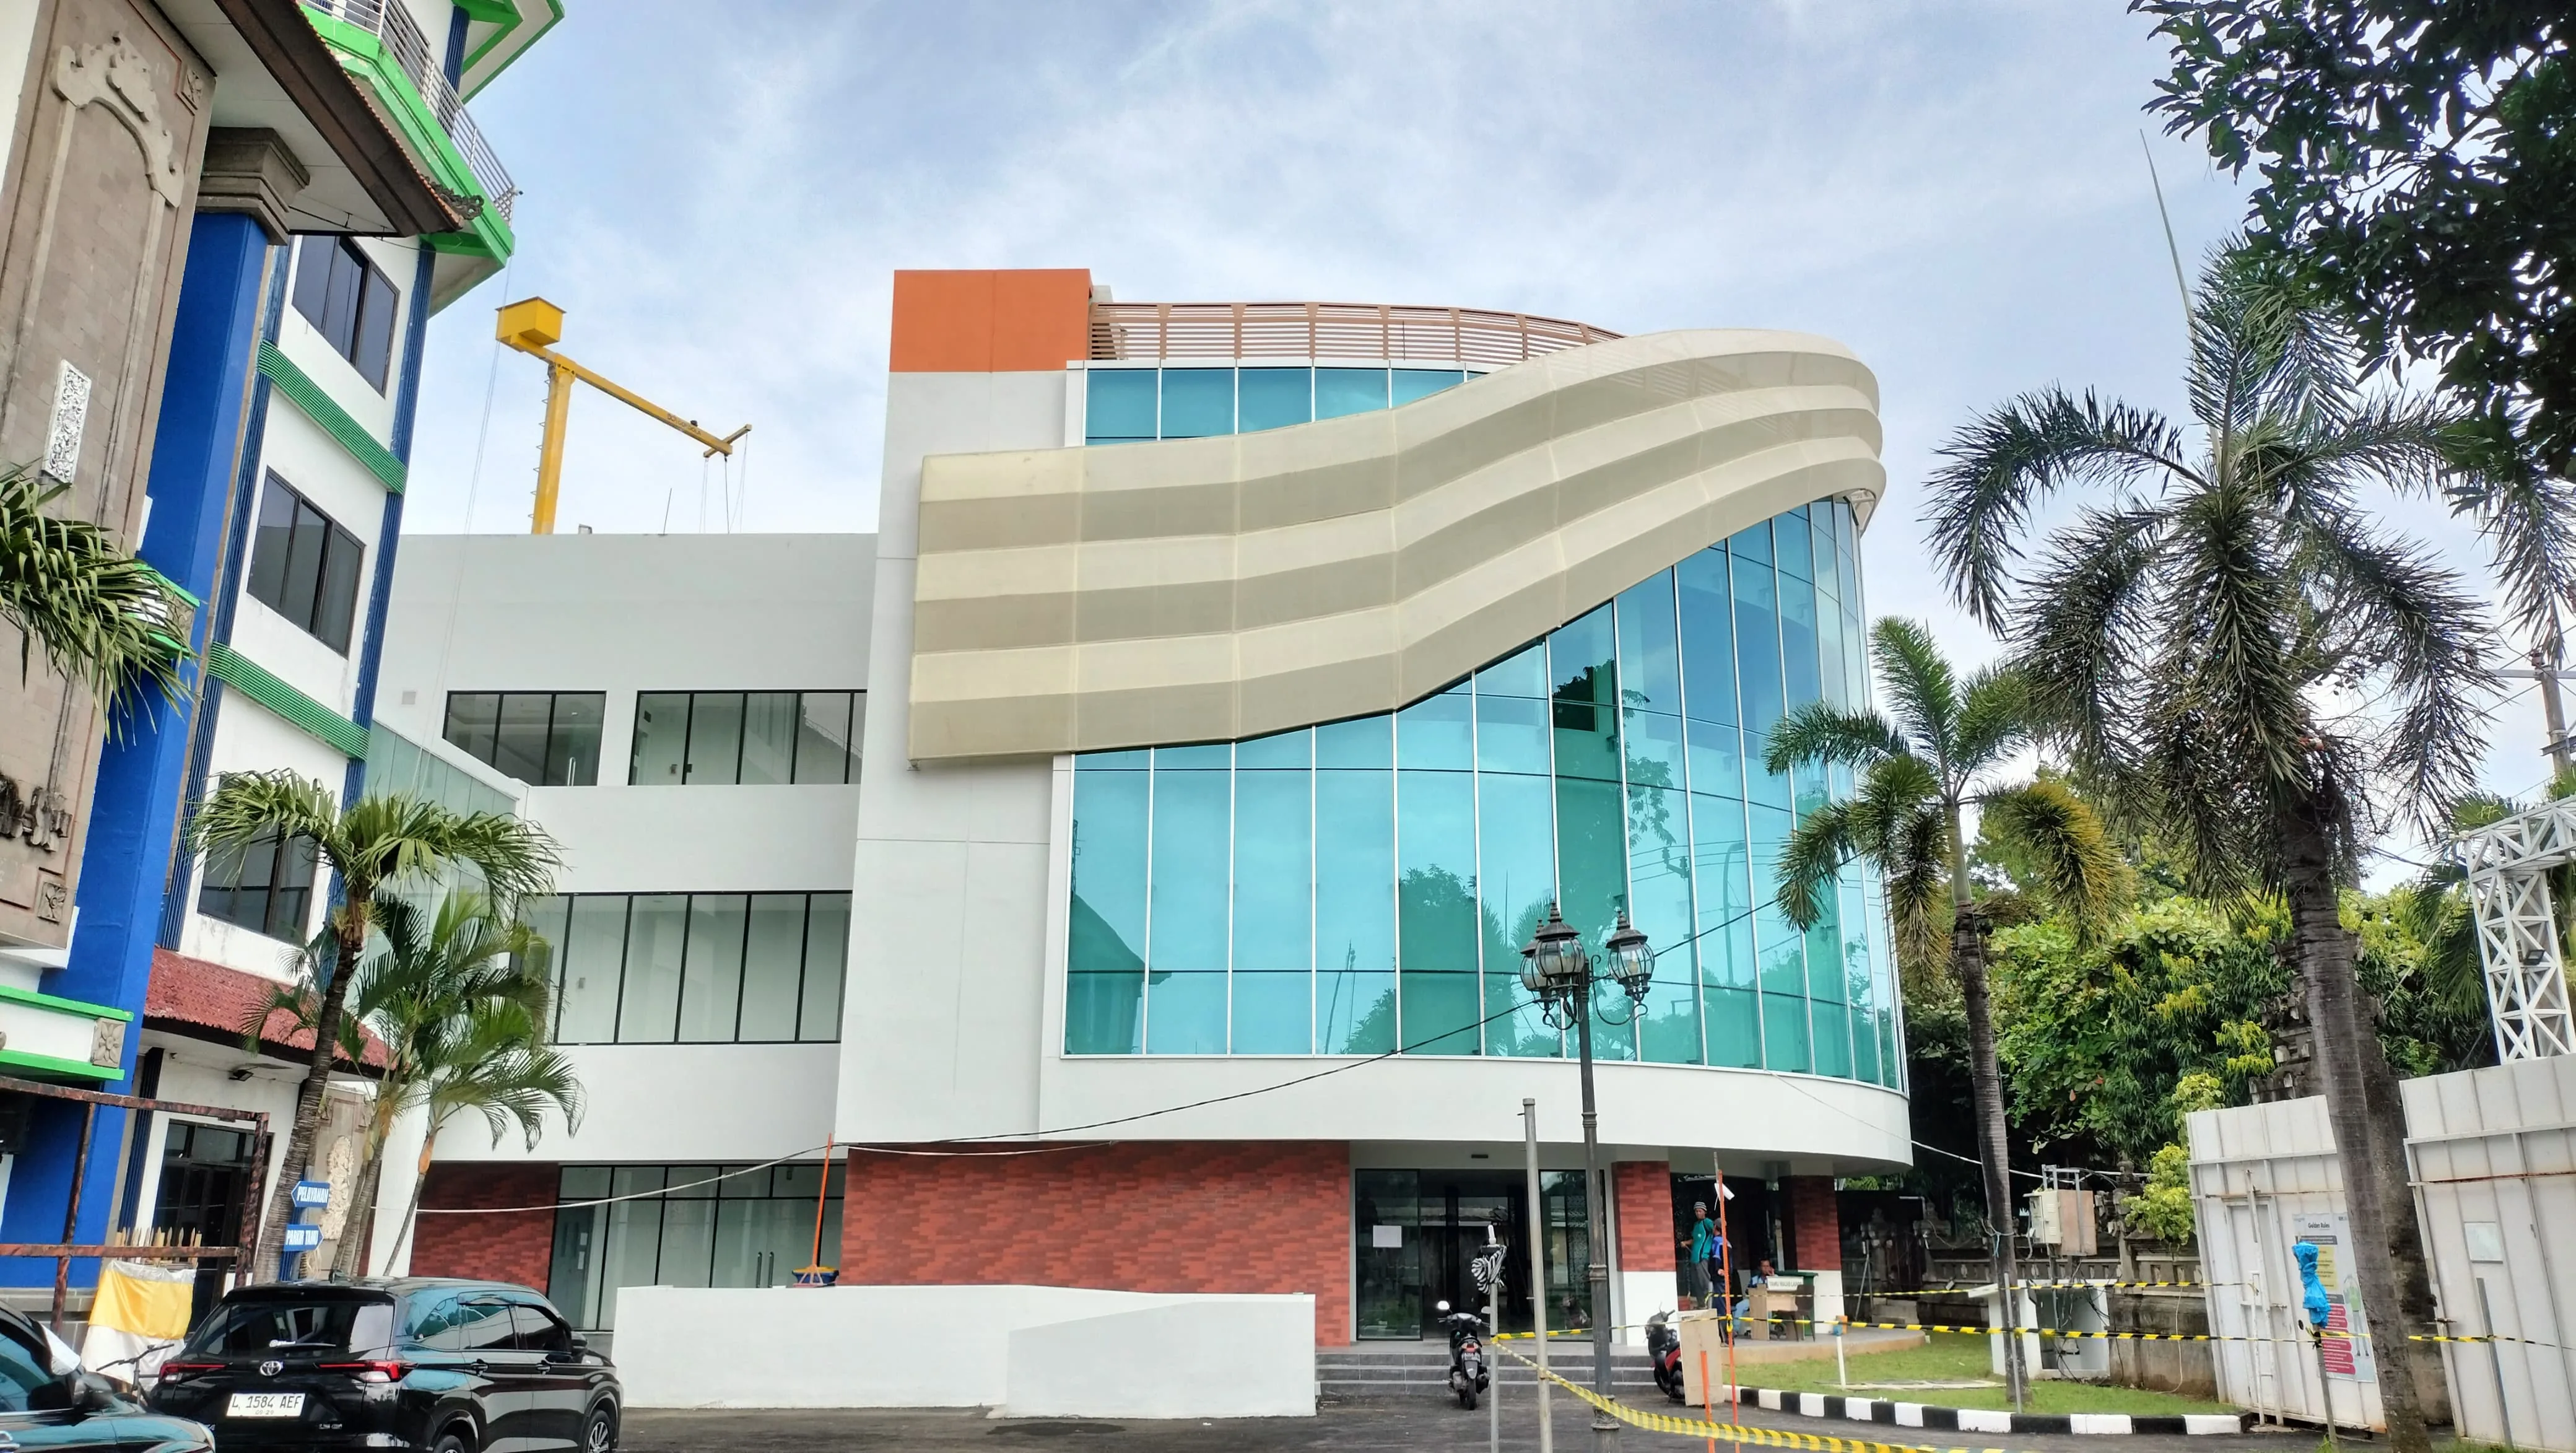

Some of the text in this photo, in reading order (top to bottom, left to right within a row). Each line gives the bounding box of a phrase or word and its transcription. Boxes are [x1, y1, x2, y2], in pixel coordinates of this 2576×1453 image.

[297, 1186, 329, 1203] PELAYANAN
[285, 1230, 319, 1245] PARKIR TAMU
[232, 1396, 302, 1408] L 1584 AEF
